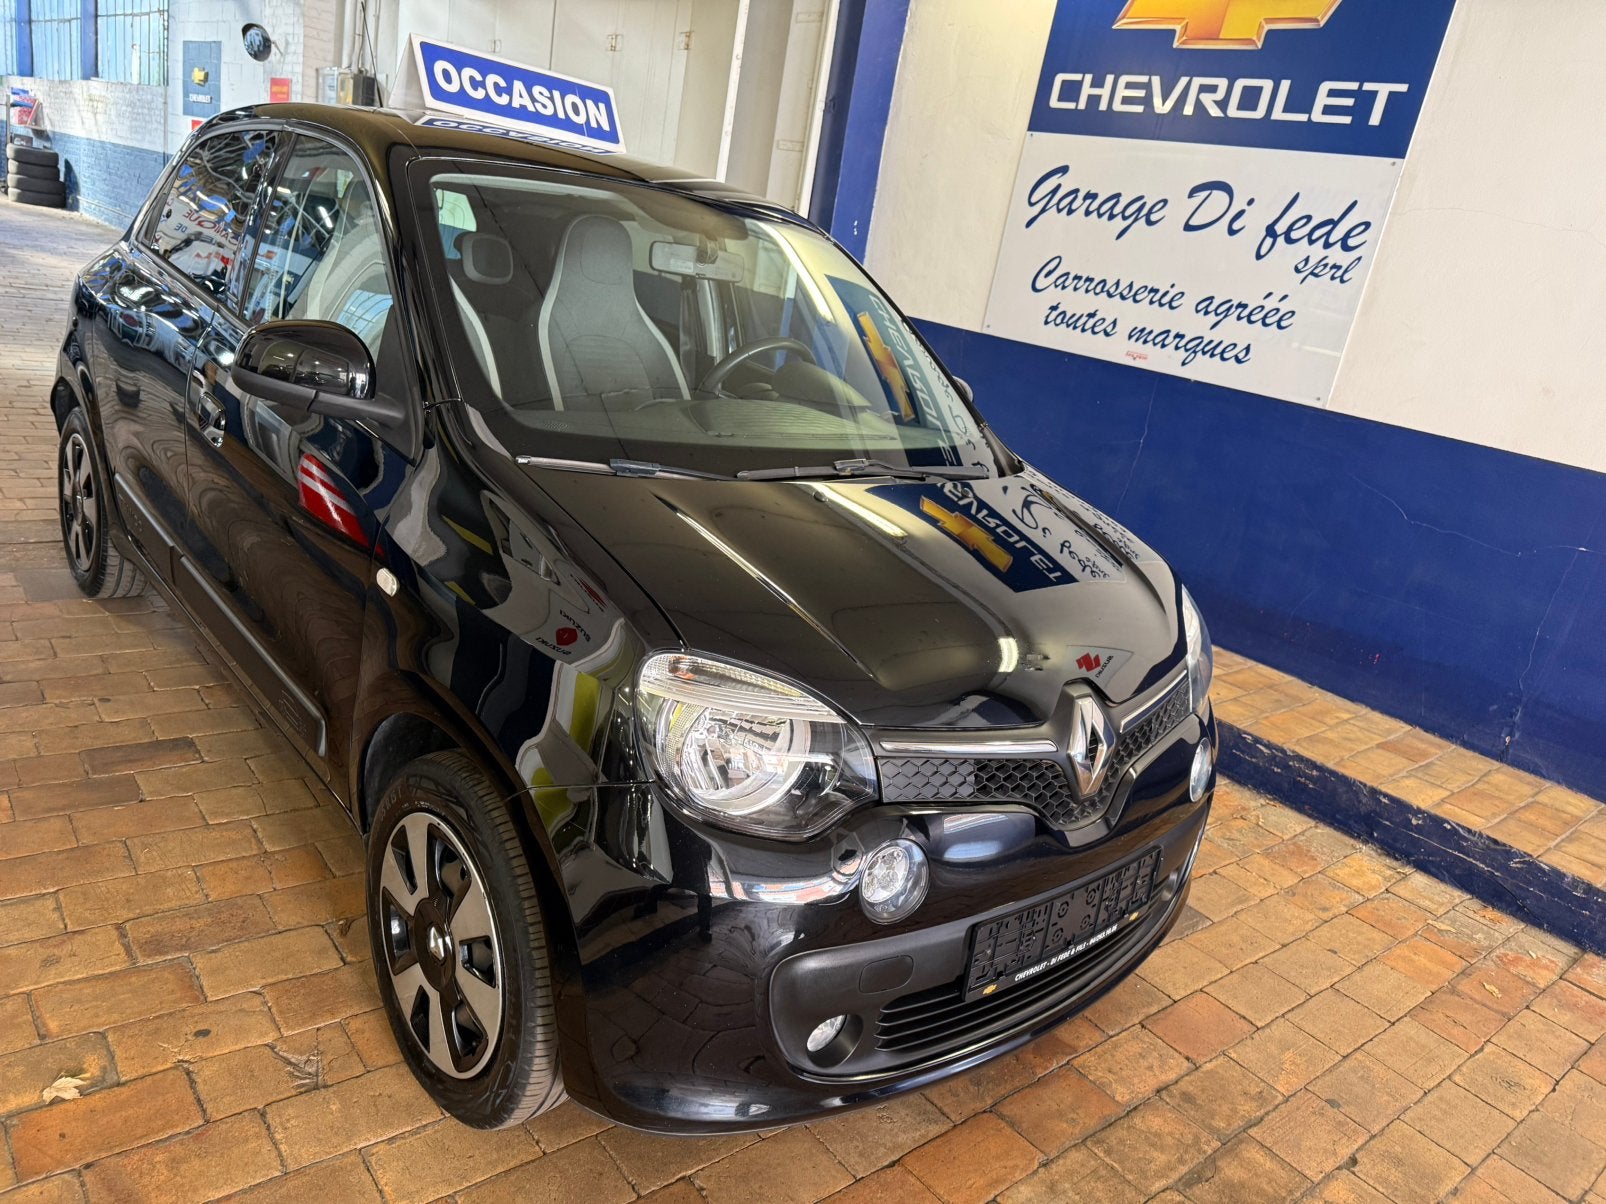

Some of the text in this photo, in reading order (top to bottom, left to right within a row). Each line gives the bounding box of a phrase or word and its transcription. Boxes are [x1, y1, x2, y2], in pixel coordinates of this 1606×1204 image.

[433, 60, 611, 132] OCCASION
[1048, 73, 1409, 126] CHEVROLET
[1024, 164, 1372, 262] Garage Di fede
[1030, 255, 1297, 331] Carrosserie agréée
[1293, 253, 1365, 286] sprl
[1044, 302, 1253, 367] toutes marques
